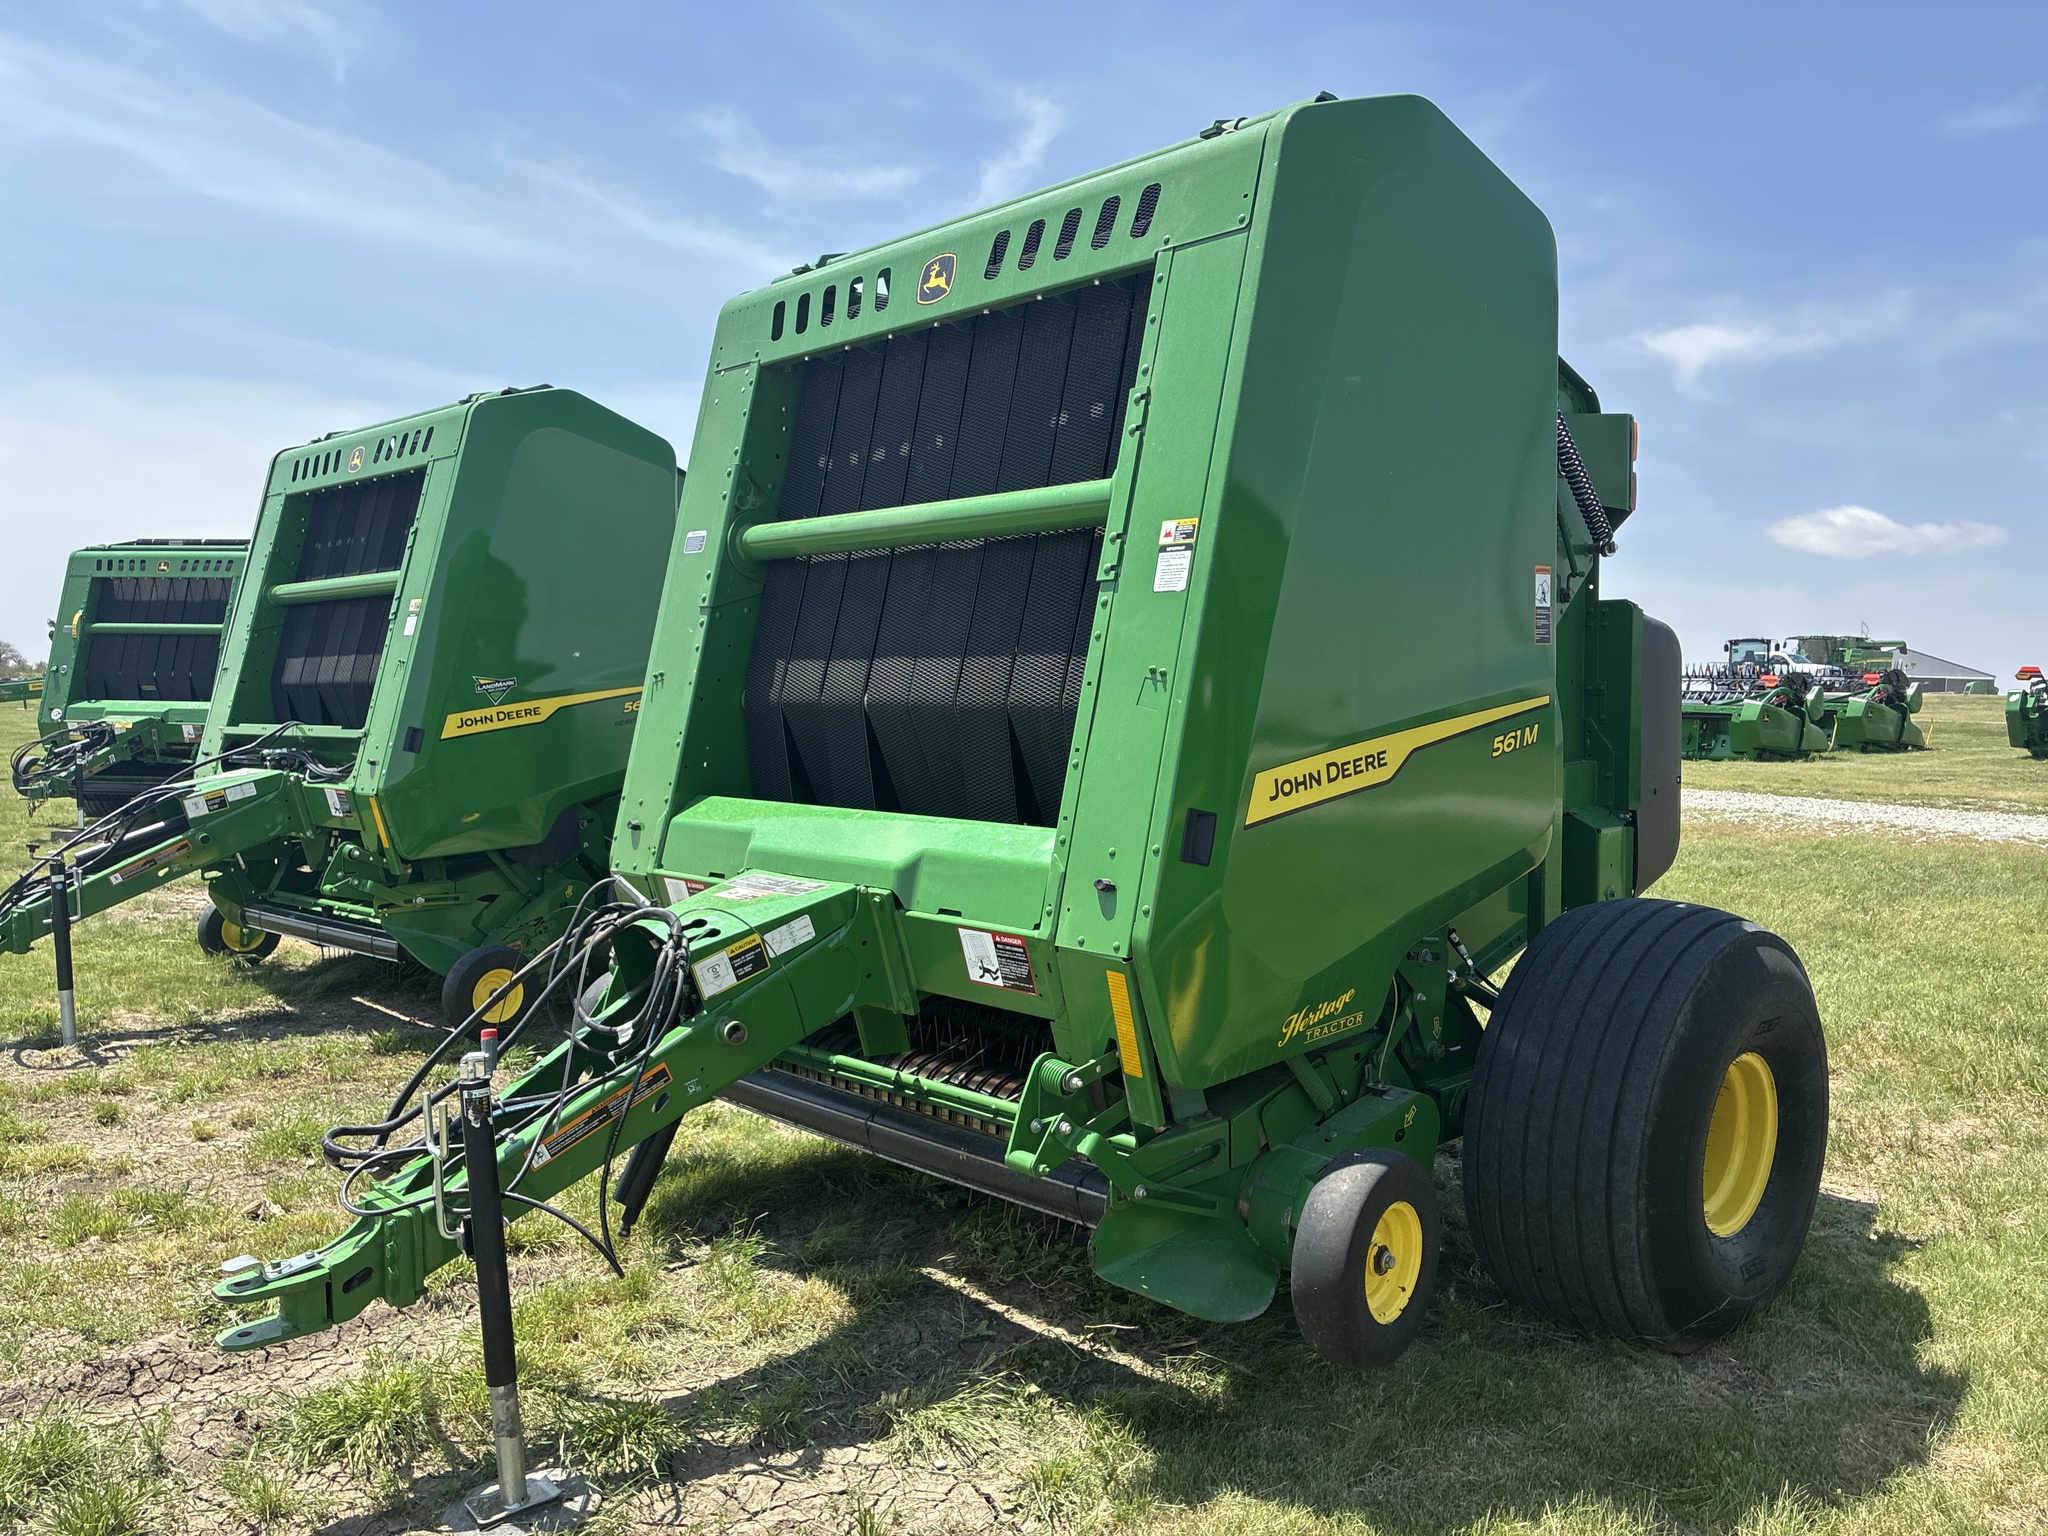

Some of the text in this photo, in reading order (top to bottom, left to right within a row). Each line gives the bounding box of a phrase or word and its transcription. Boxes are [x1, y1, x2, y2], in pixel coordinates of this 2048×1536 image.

[457, 706, 541, 729] JOHN DEERE
[1491, 722, 1540, 759] 561 M
[1269, 750, 1388, 802] JOHN DEERE
[735, 937, 757, 952] CAUTION
[1000, 936, 1022, 945] DANGER
[1277, 988, 1356, 1048] Heritage
[1305, 1013, 1363, 1041] TRACTOR
